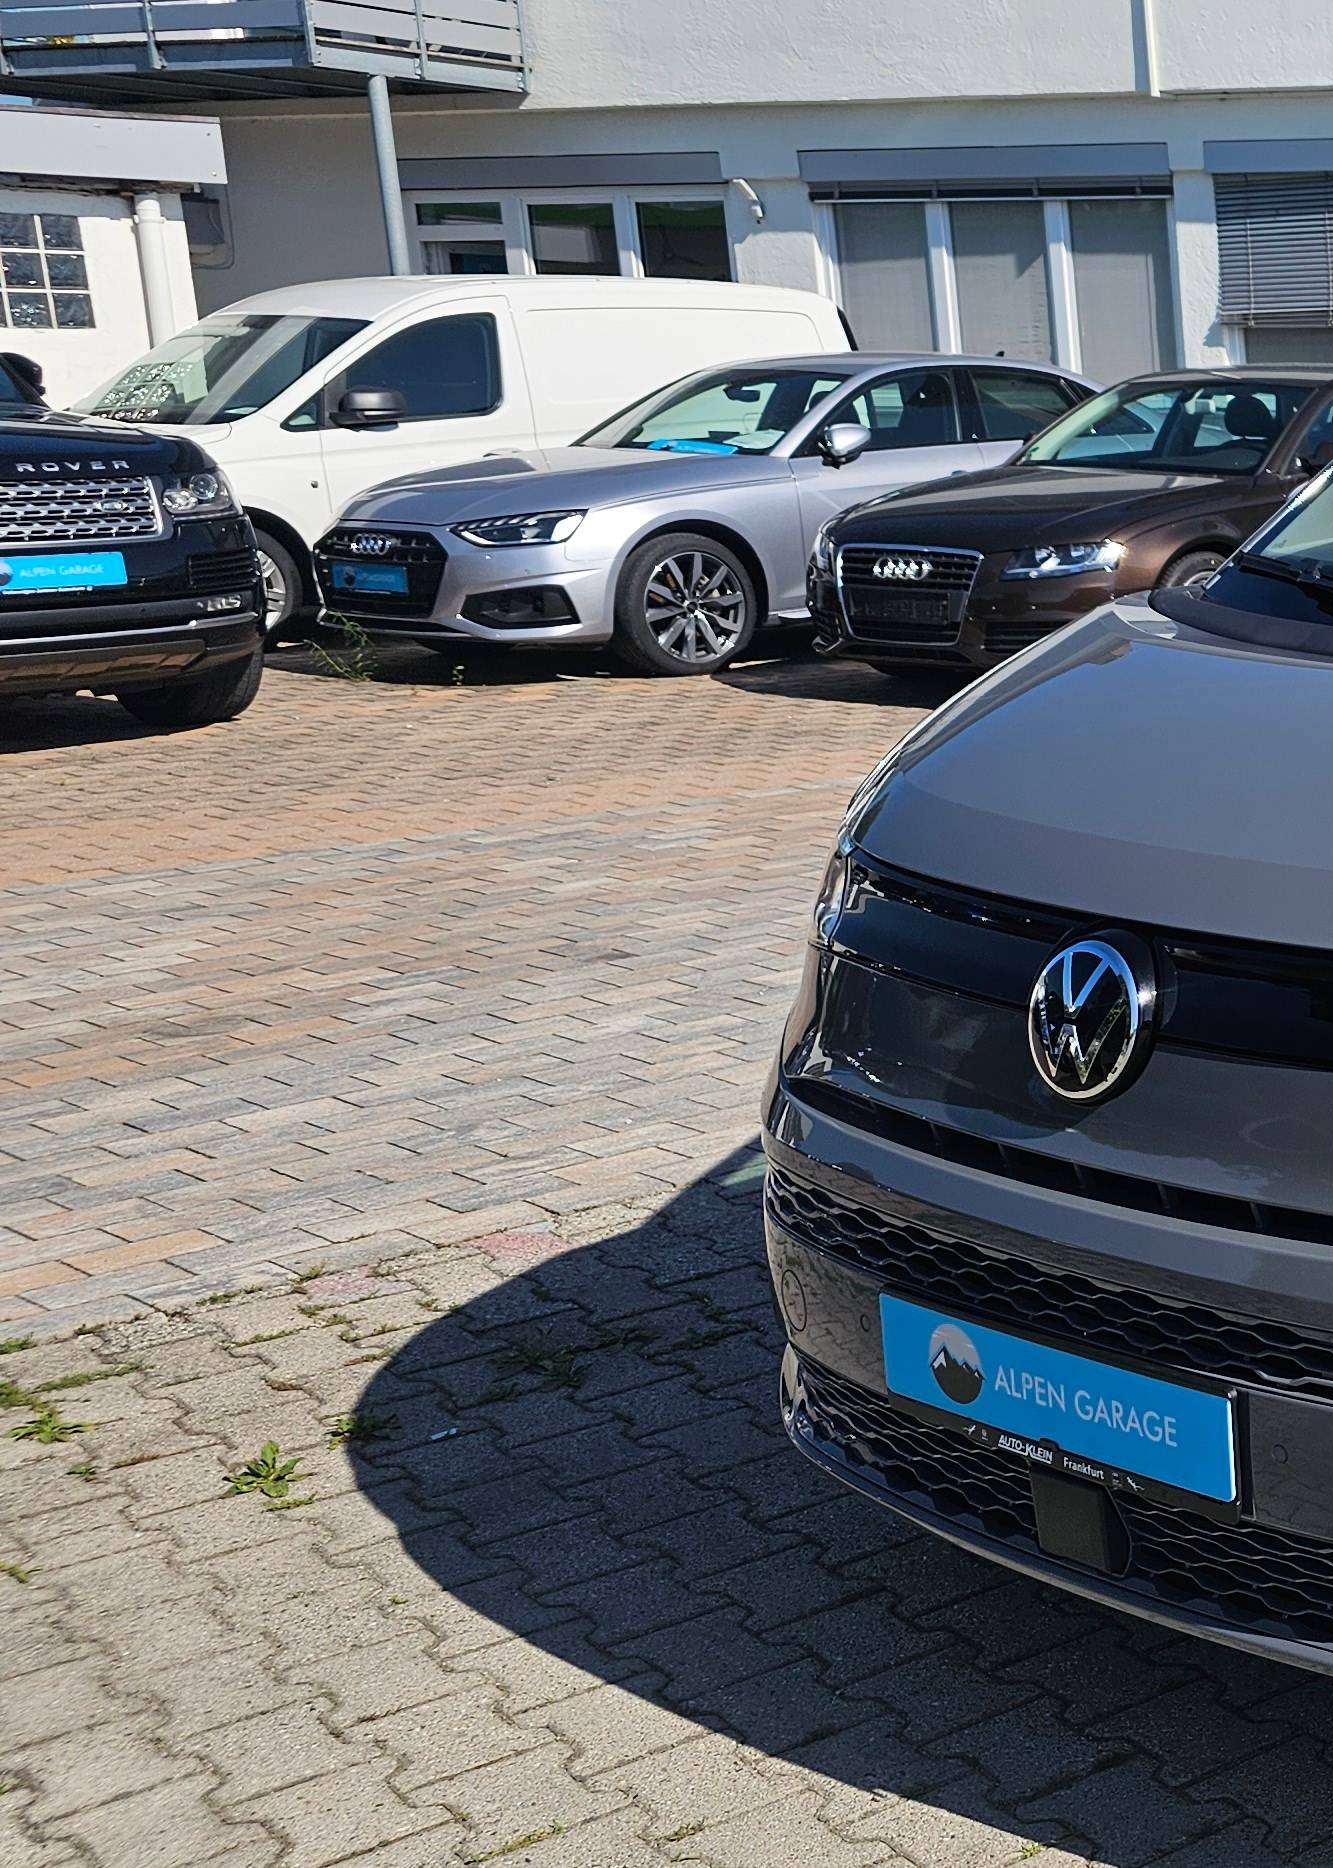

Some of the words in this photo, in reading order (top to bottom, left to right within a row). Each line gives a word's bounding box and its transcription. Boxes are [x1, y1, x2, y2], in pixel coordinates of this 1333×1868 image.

[15, 460, 130, 472] ROVER
[58, 563, 104, 575] GARAGE
[994, 1364, 1067, 1413] ALPEN
[1074, 1389, 1178, 1448] GARAGE
[998, 1434, 1053, 1464] AUTO-KLEIN
[1063, 1456, 1105, 1480] Frankfurt
